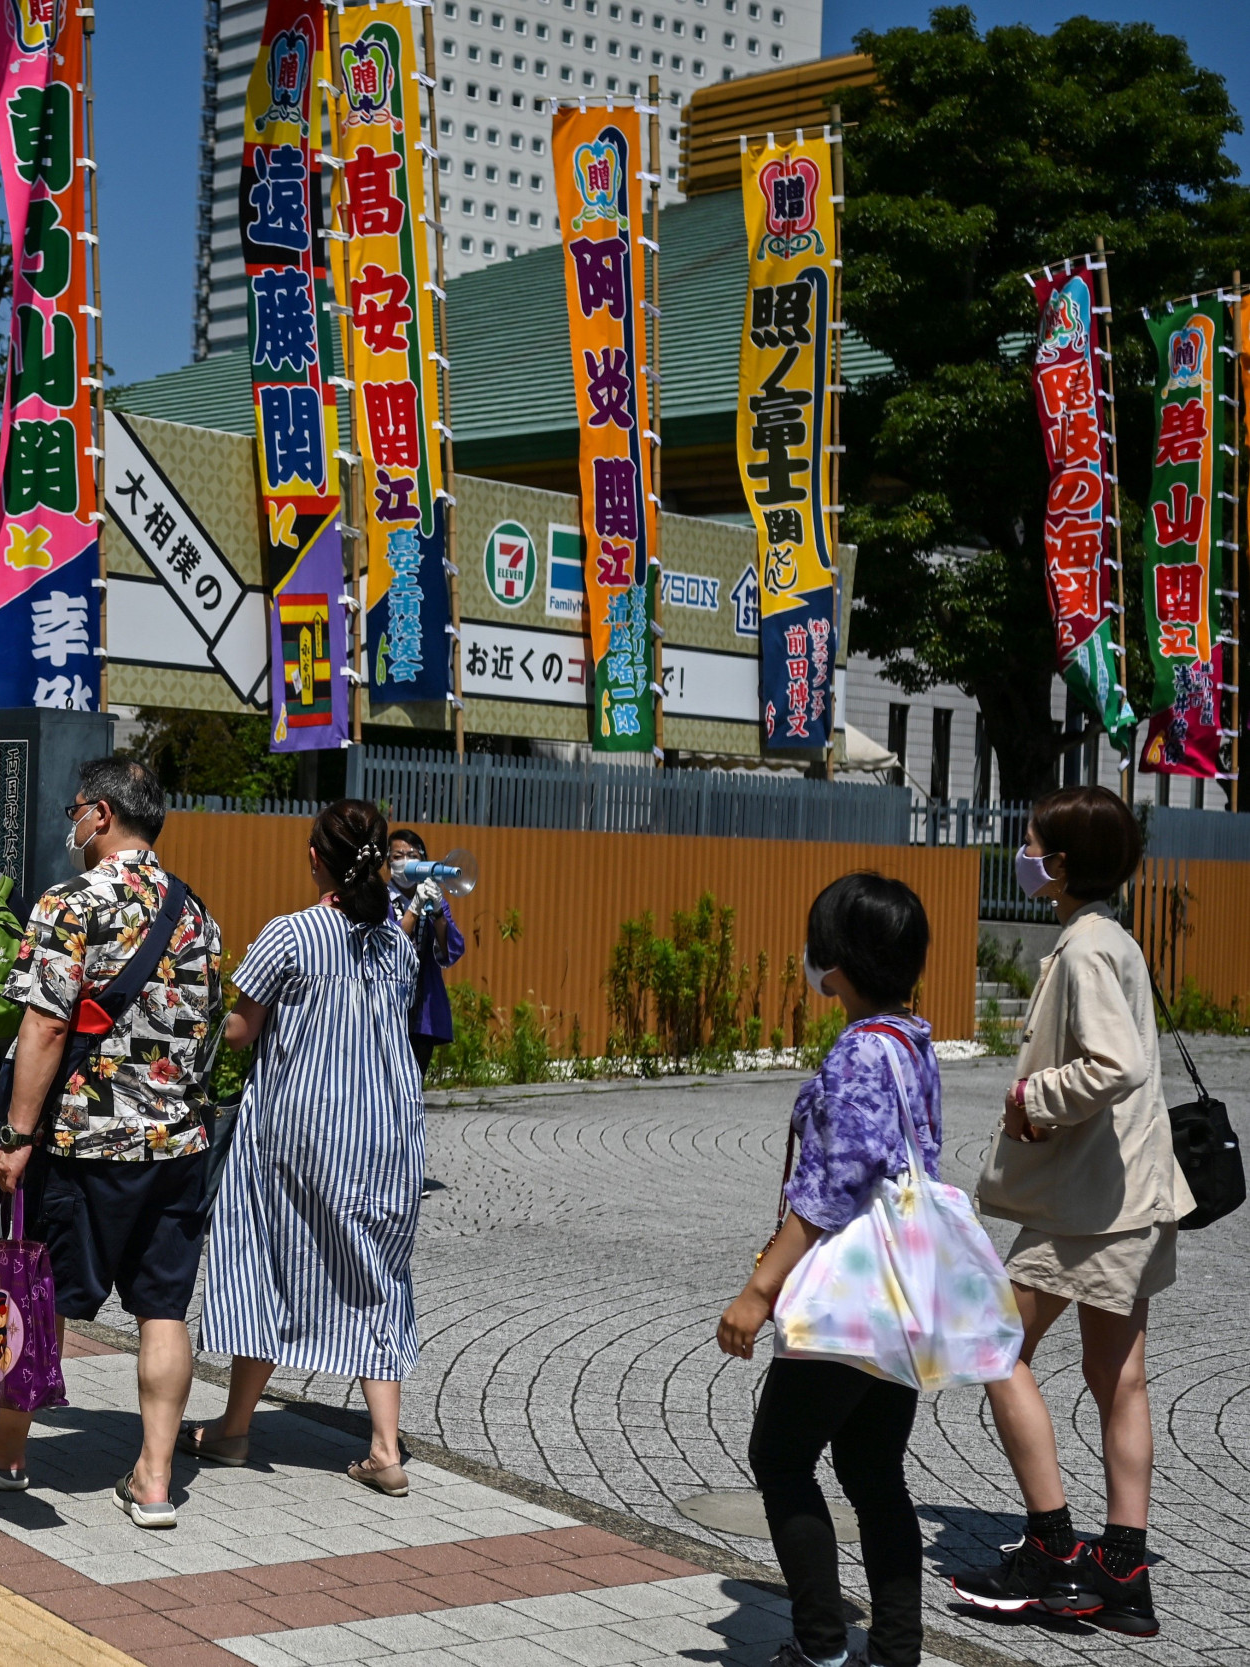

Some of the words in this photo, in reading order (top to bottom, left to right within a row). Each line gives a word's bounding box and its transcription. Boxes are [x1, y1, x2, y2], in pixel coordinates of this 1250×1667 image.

[350, 60, 380, 97] 贈
[588, 158, 611, 192] 贈
[773, 177, 806, 220] 贈
[115, 469, 223, 611] 大相撲の
[1151, 397, 1209, 658] 碧山関江
[784, 624, 810, 739] 前田博文
